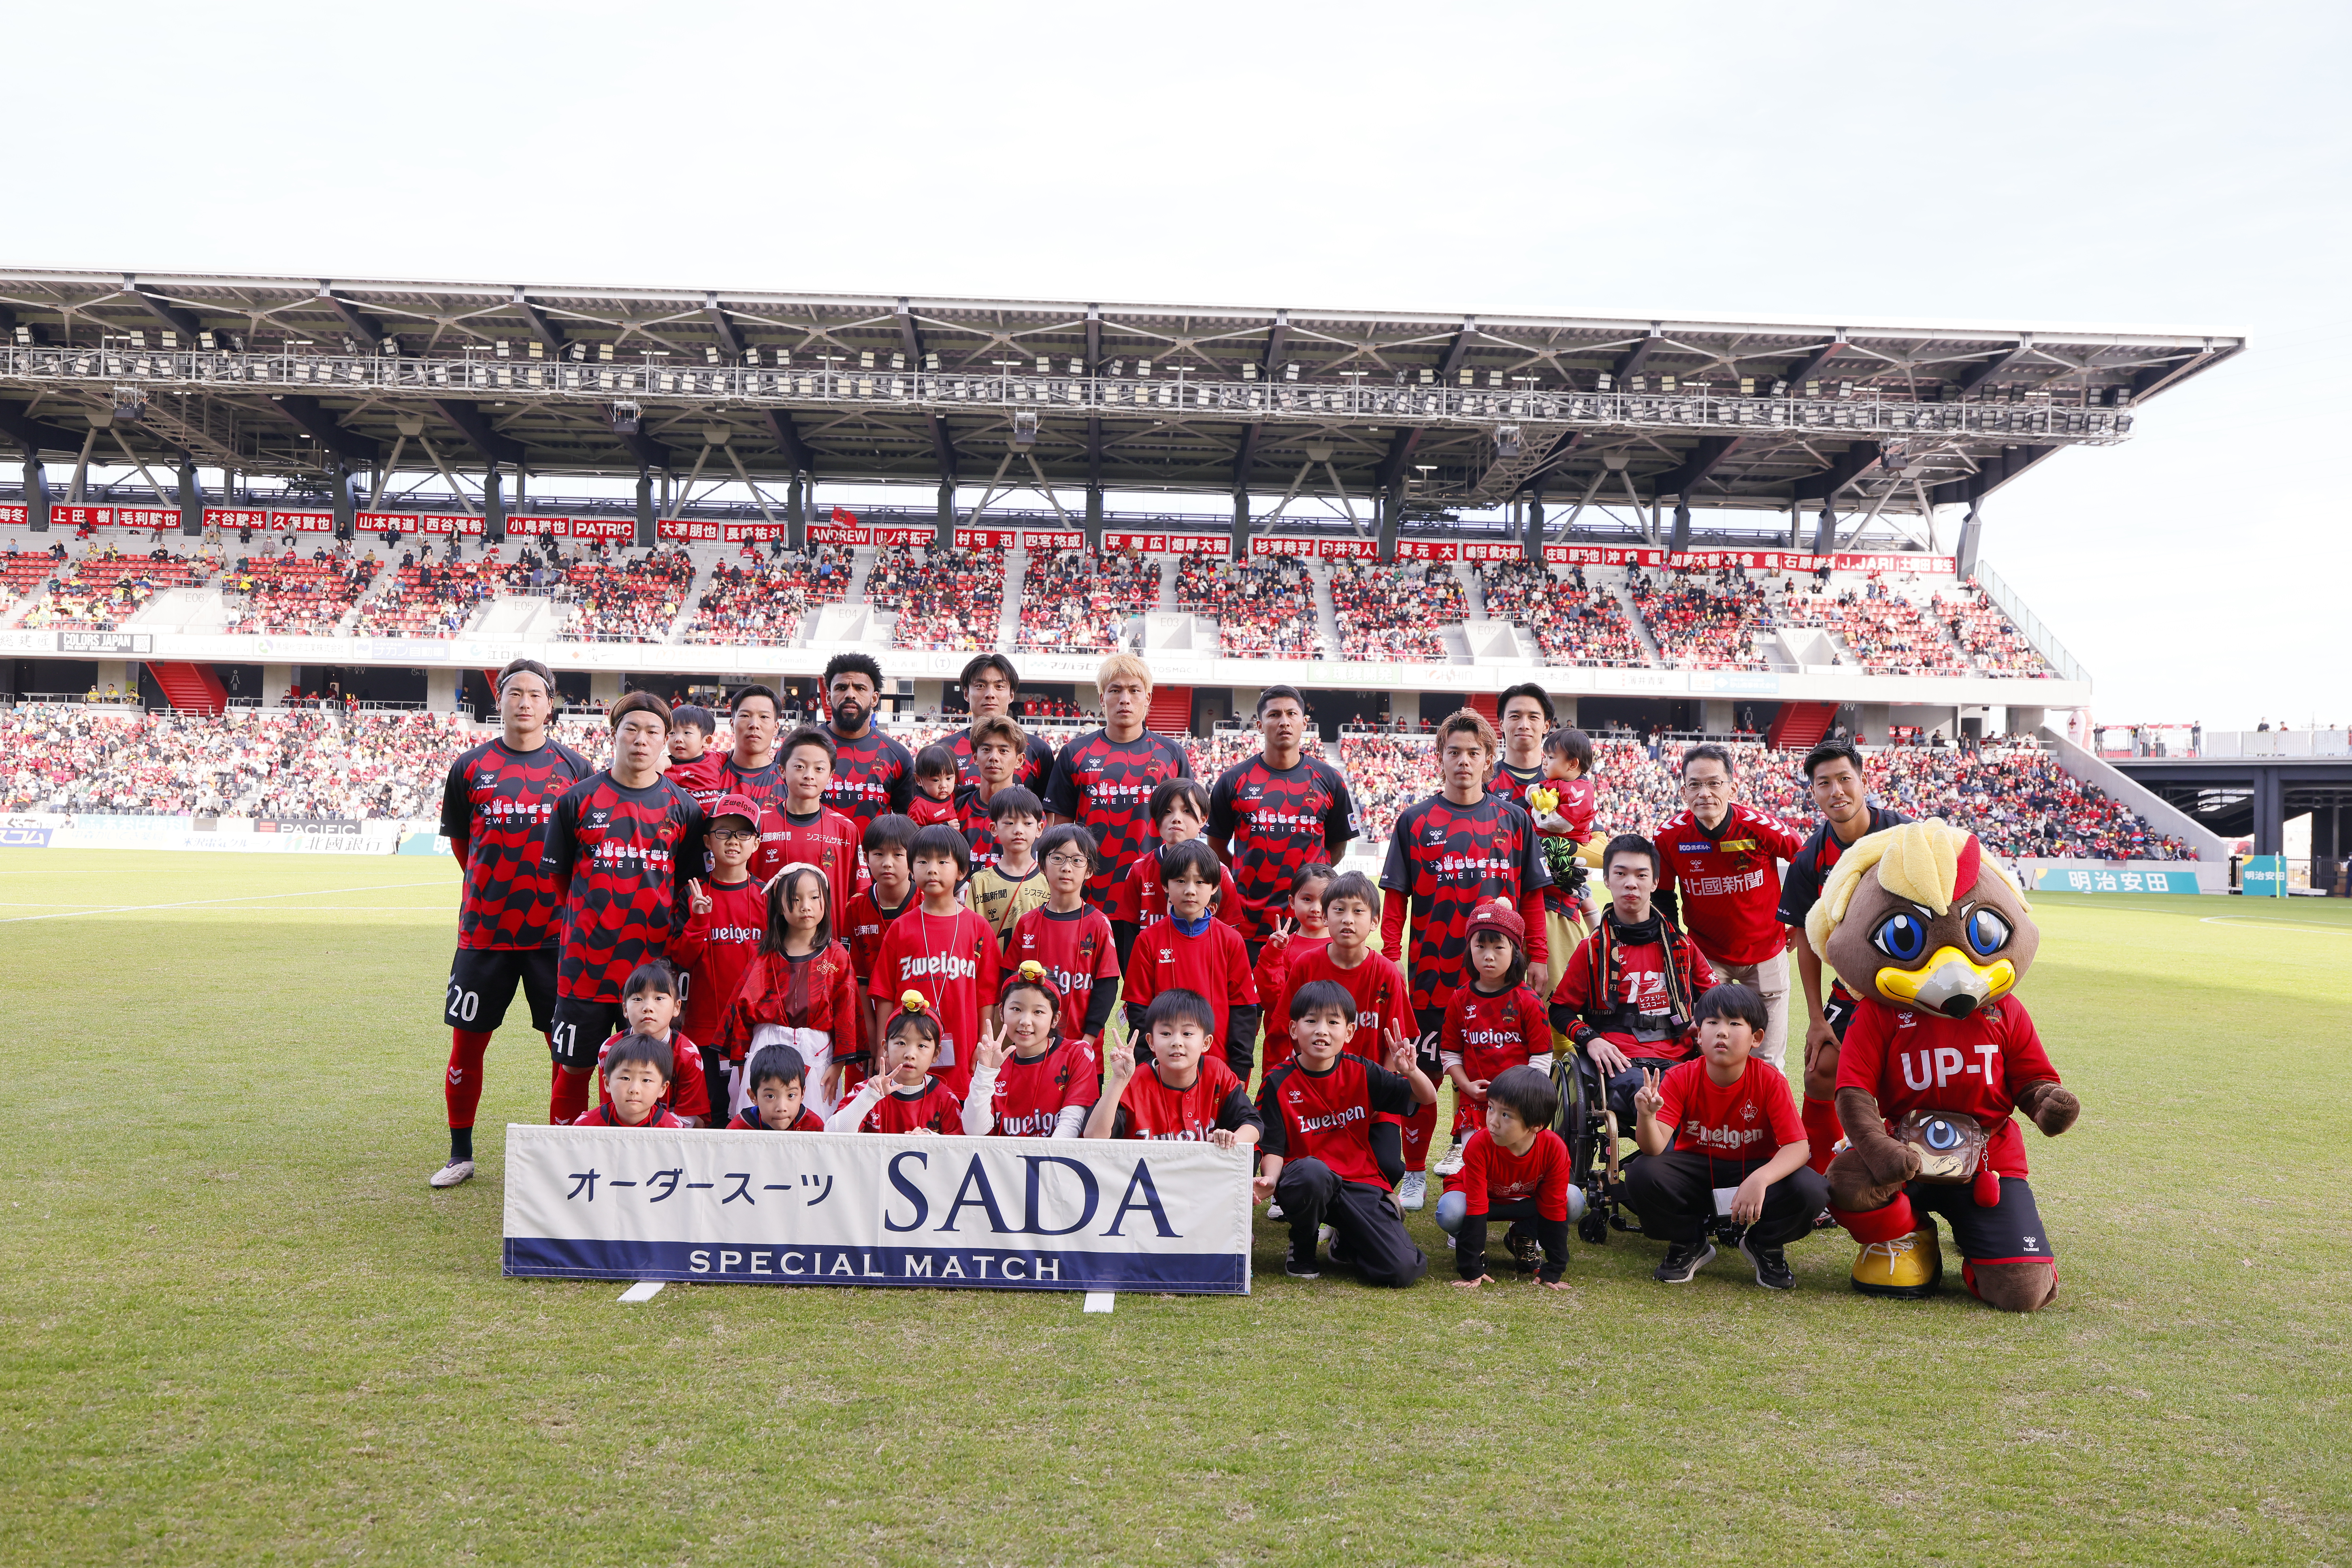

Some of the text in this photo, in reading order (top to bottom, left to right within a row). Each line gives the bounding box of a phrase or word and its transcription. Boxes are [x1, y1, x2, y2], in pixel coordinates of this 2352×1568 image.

[121, 511, 177, 526] 毛利駿也
[207, 512, 263, 526] 大谷駿斗
[273, 515, 330, 530] 久保賢也
[359, 516, 415, 531] 山本義道
[426, 518, 482, 533] 西谷優希
[510, 519, 565, 533] 小島雅也
[577, 522, 631, 536] PATRIC
[661, 522, 716, 537] 大澤朋也
[813, 528, 867, 542] ANDREW
[1025, 535, 1080, 548] 四宮悠成
[1172, 538, 1226, 552] 畑尾大翔
[1256, 540, 1310, 554] 杉浦恭平
[185, 593, 204, 602] E06
[515, 601, 533, 610] E05
[839, 609, 857, 618] E04
[1161, 618, 1179, 626] E03
[1478, 626, 1496, 635] E02
[64, 634, 130, 647] COLORS JAPAN
[1794, 634, 1809, 643] E01
[276, 642, 343, 652] 馬場化学工業株式会社
[374, 647, 445, 657] ナカノ自動車
[488, 650, 522, 660] 江口組
[1332, 665, 1393, 682] 環境開発
[722, 799, 755, 816] Zweigen
[80, 820, 100, 829] Aoba
[102, 818, 184, 831] あおば歯科
[281, 824, 356, 834] PACIFIC
[72, 831, 164, 841] 中森かいてき薬局
[183, 837, 273, 848] 米沢電気グループ
[806, 832, 851, 847] システムサポート
[305, 836, 383, 852] 北國銀行
[594, 860, 668, 871] ZWEIGEN
[1437, 871, 1508, 881] ZWEIGEN
[1683, 869, 1764, 896] 北國新聞
[2069, 871, 2169, 892] 明治安田
[2244, 871, 2285, 881] 明治安田
[976, 889, 1007, 904] 北國新聞
[704, 924, 761, 944] weigen
[830, 963, 839, 973] ONE
[899, 951, 976, 981] Zweigen
[449, 984, 479, 1021] 20
[1640, 1000, 1666, 1008] エスコート
[552, 1021, 576, 1056] 41
[1901, 1044, 1998, 1091] UP-T
[1297, 1106, 1366, 1133] Zweigen
[1686, 1121, 1763, 1149] Zweigen
[1696, 1140, 1727, 1149] KANAZAWA
[567, 1151, 1183, 1238] オーダースーツ SADA
[689, 1250, 1061, 1281] SPECIAL MATCH
